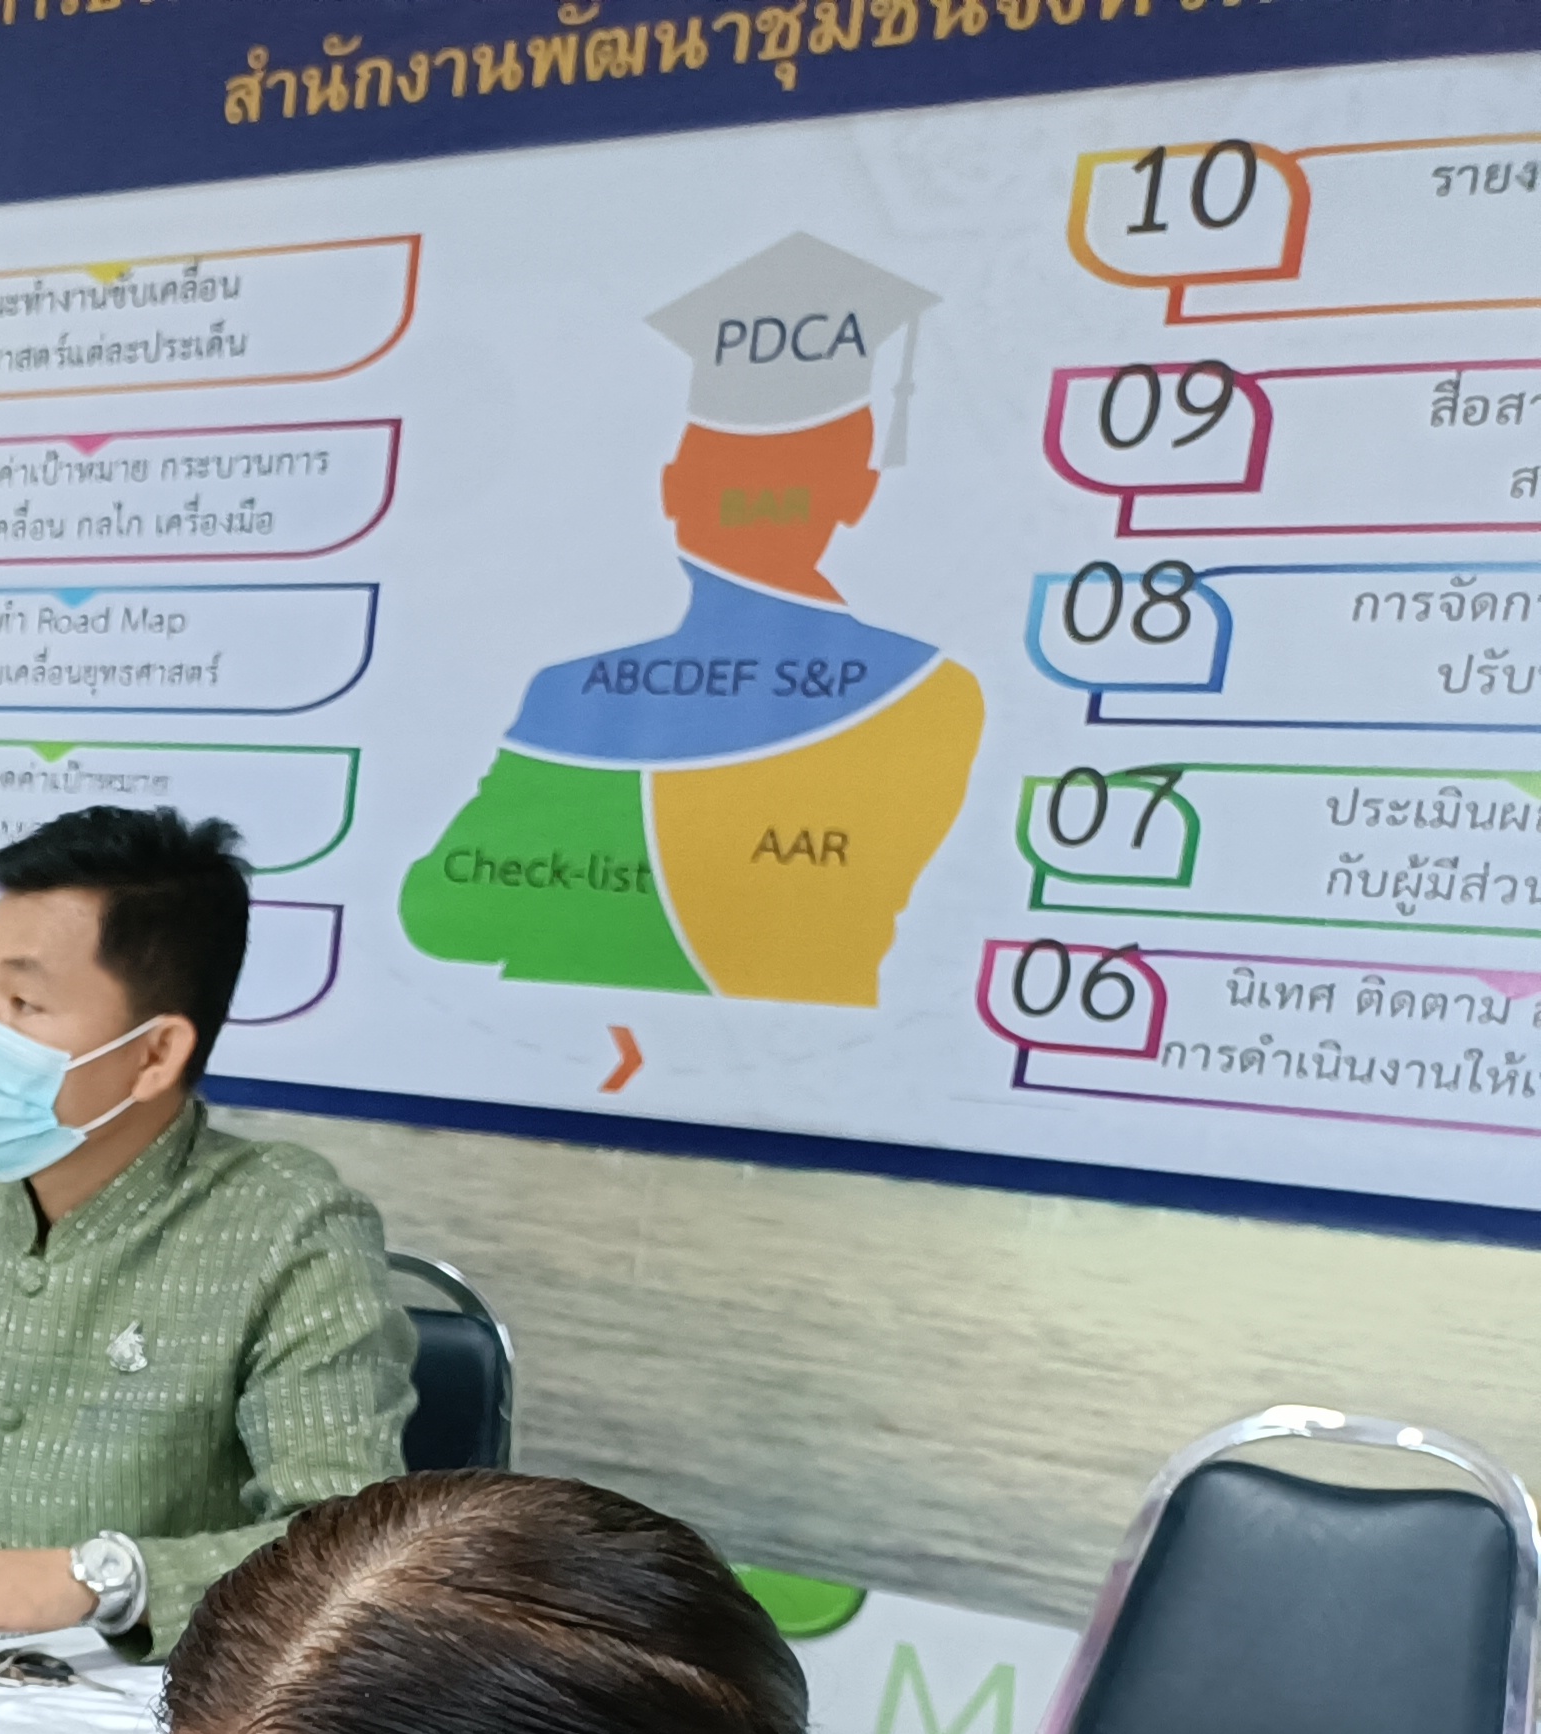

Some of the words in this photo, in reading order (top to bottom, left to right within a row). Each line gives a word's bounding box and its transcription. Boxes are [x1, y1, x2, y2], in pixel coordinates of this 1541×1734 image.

[1126, 139, 1258, 237] 10
[716, 313, 868, 365] PDCA
[1099, 360, 1237, 449] 09
[161, 449, 330, 482] กระบวนการ
[77, 502, 142, 537] กลไก
[156, 494, 273, 535] เครื่องมือ
[38, 607, 111, 634] Road
[121, 607, 186, 639] Map
[1063, 560, 1195, 645] 08
[582, 658, 758, 697] ABCDEF
[773, 659, 867, 698] S&P
[1049, 766, 1185, 849] 07
[443, 846, 651, 896] Check-list
[751, 826, 849, 867] AAR
[1012, 939, 1139, 1022] 06
[1226, 967, 1336, 1013] นิเทศ
[1356, 976, 1511, 1026] ติดตาม
